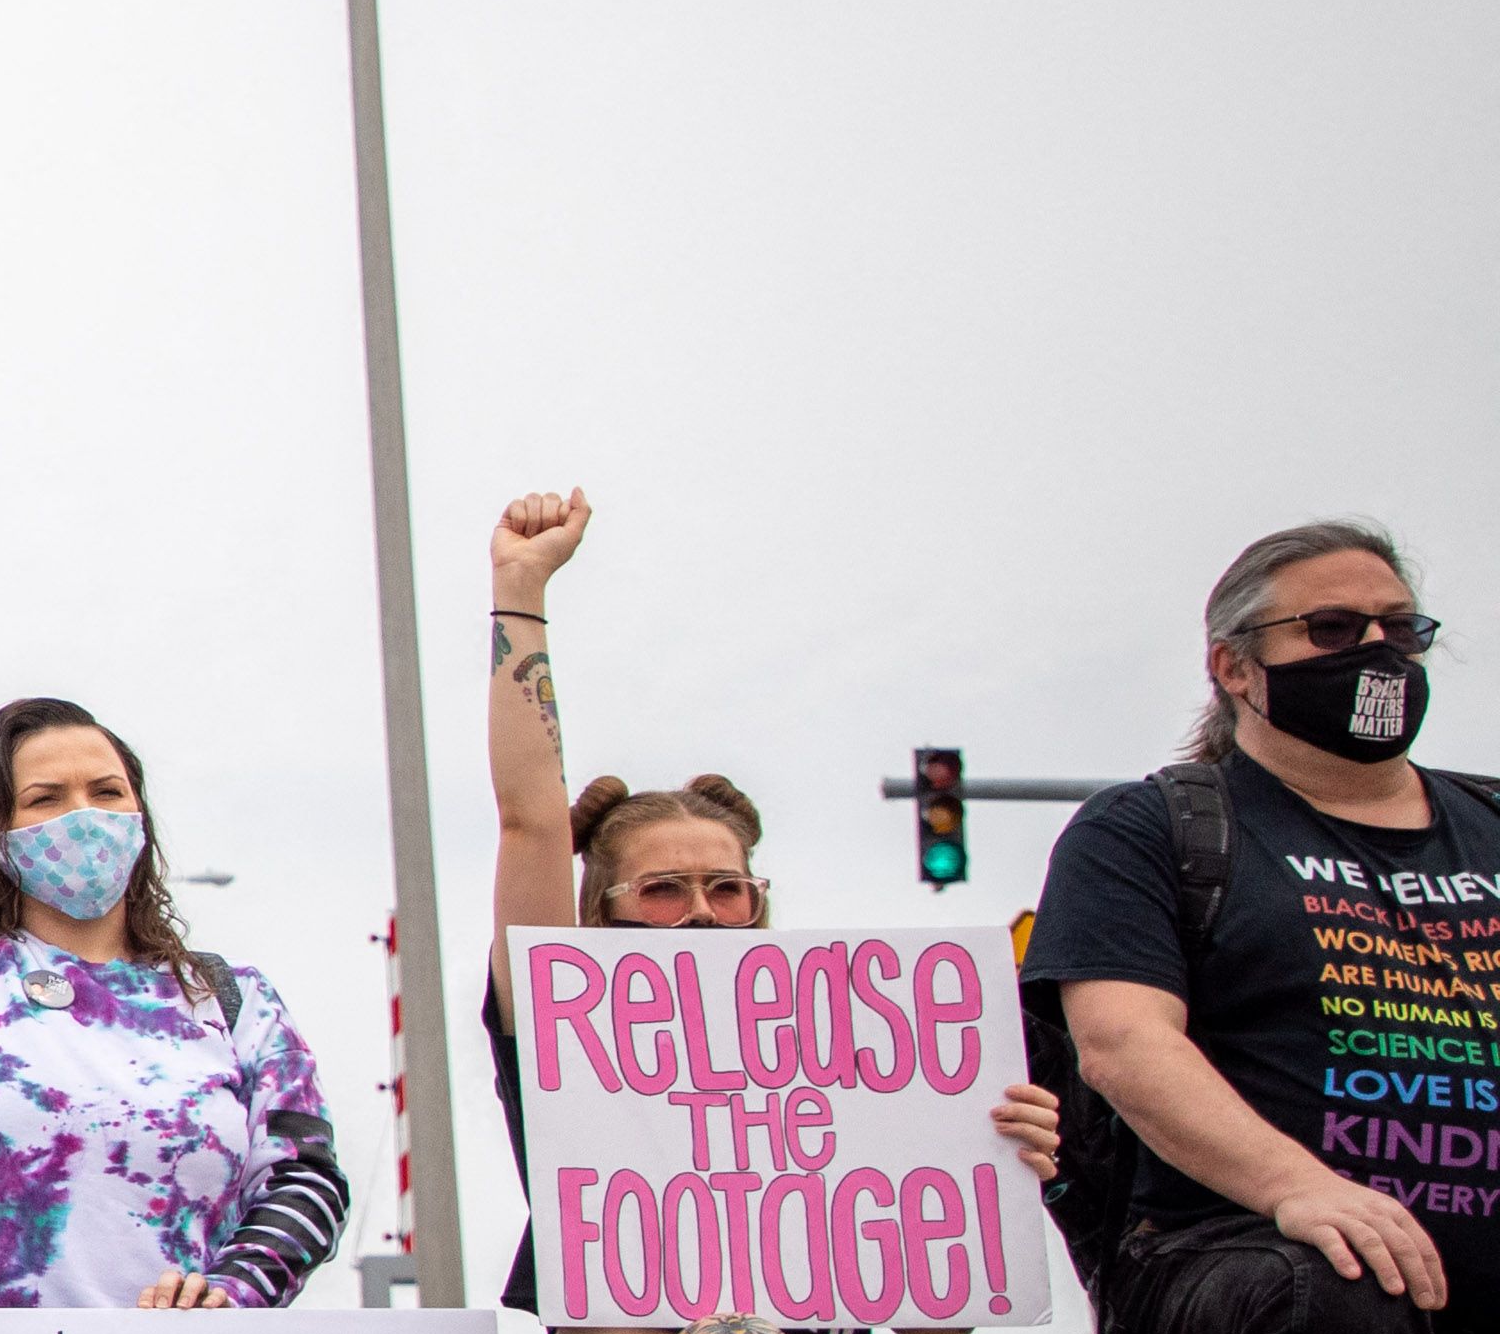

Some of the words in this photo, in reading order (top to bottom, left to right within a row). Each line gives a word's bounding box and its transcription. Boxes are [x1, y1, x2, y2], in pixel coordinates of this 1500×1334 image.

[1349, 714, 1403, 736] MATTER
[1355, 696, 1404, 717] VOTERS
[1286, 855, 1367, 889] WE
[1303, 895, 1391, 927] BLACK
[1397, 911, 1453, 940] LIES
[1319, 963, 1376, 986] ARE
[1383, 969, 1486, 1001] HUMAN
[1321, 996, 1365, 1016] NO
[1373, 1000, 1471, 1028] HUMAN
[1478, 1011, 1498, 1029] IS
[1328, 1029, 1485, 1066] SCIENCE
[1324, 1068, 1452, 1107] LOVE
[1464, 1078, 1498, 1112] IS
[1322, 1112, 1500, 1171] KIND
